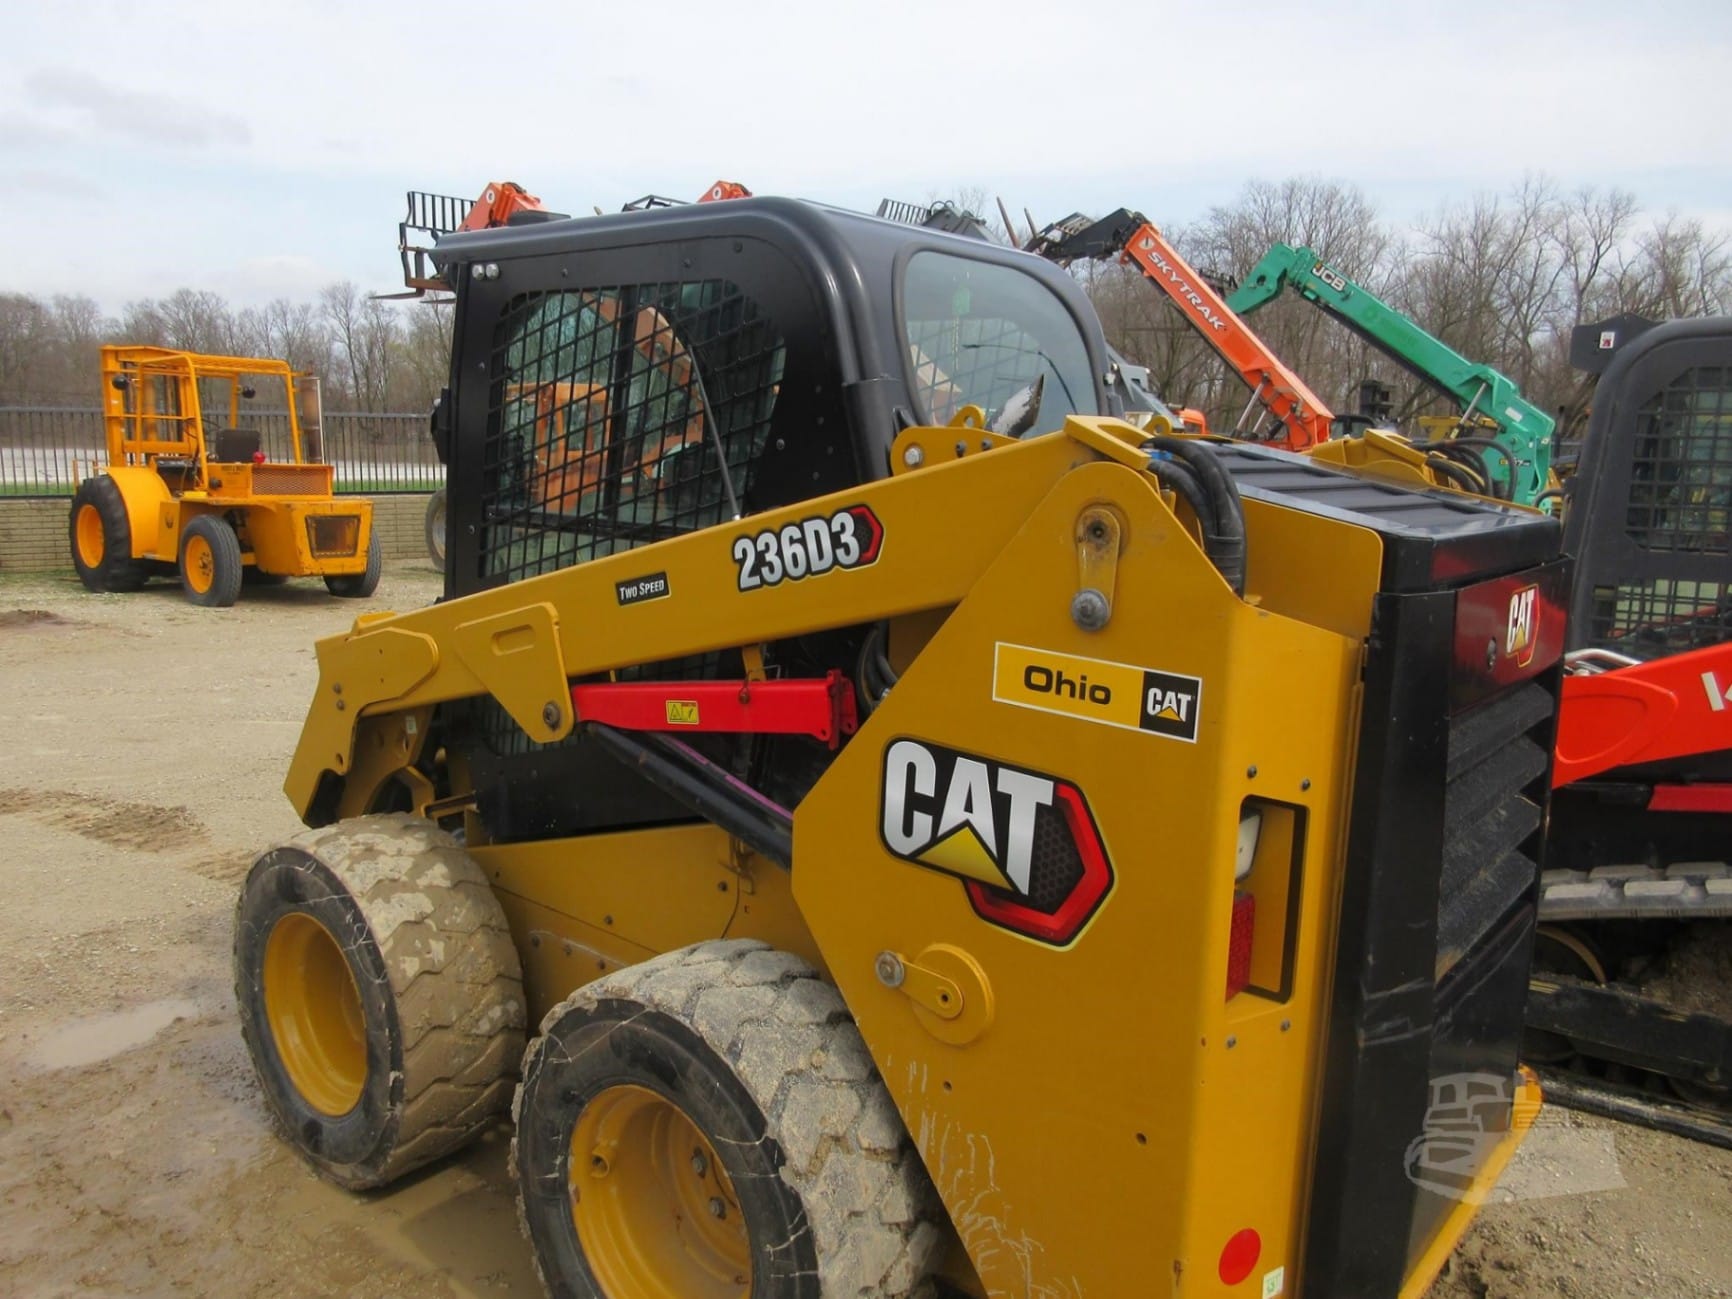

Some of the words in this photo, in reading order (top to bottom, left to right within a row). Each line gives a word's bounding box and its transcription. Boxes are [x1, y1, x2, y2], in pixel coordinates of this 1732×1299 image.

[1147, 251, 1226, 330] SKYTRAK
[1312, 265, 1346, 292] JCB
[733, 511, 860, 589] 236D3
[1506, 588, 1535, 653] CAT
[1023, 664, 1112, 706] Ohio
[1146, 687, 1192, 723] CAT
[884, 740, 1054, 896] CAT
